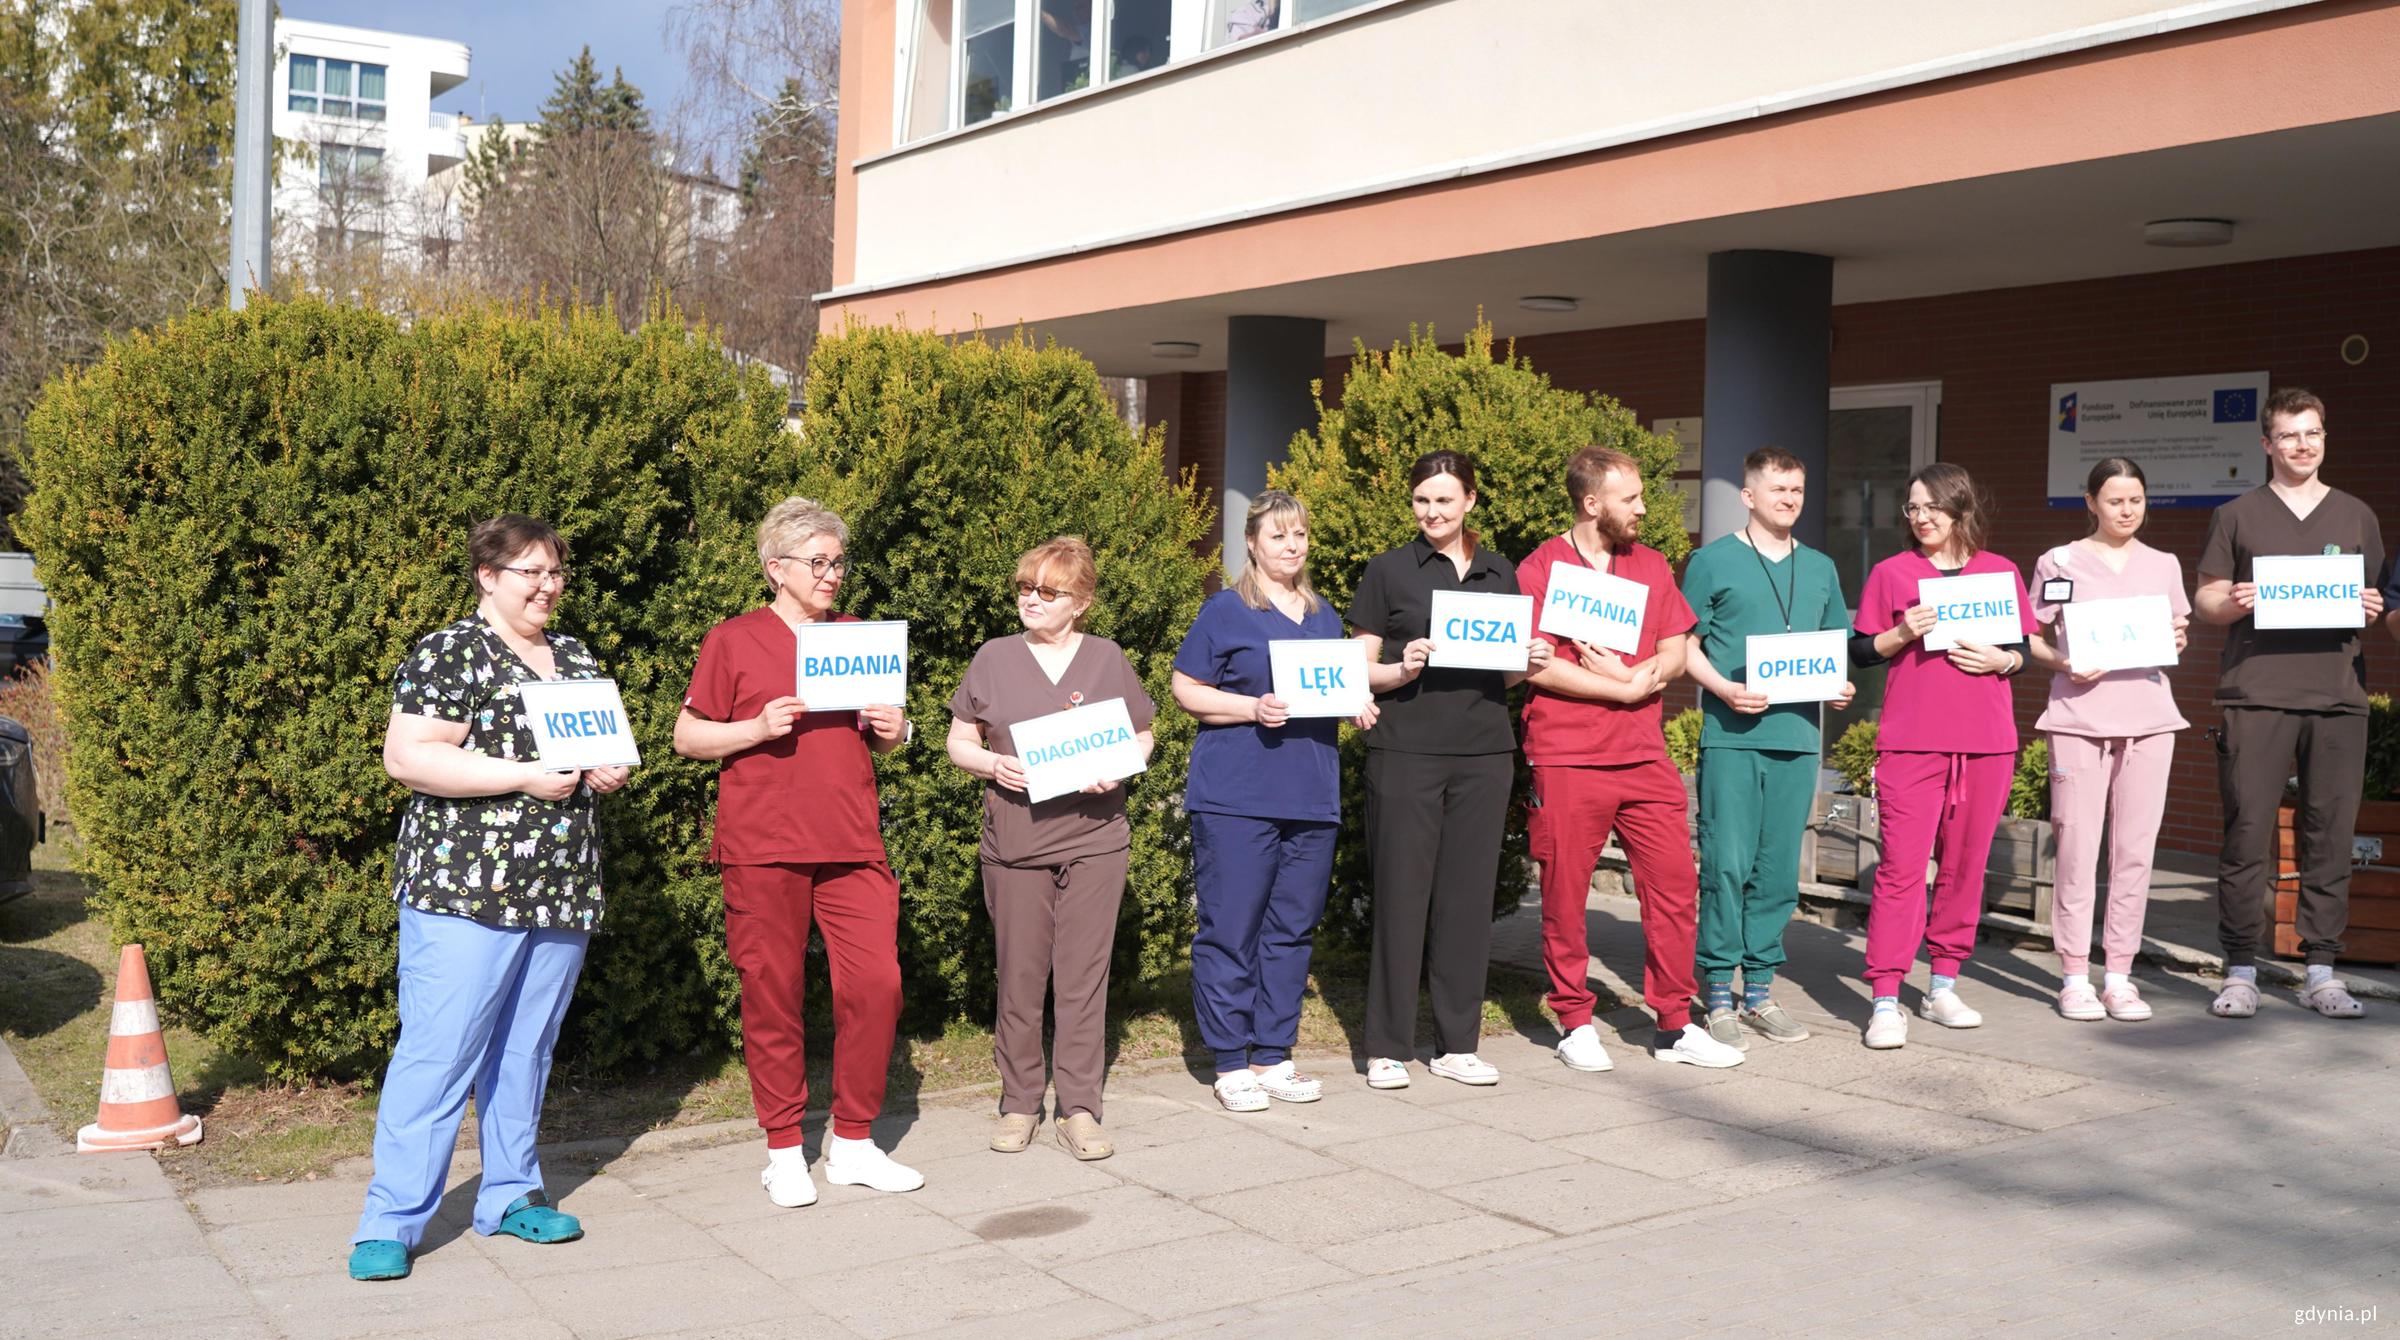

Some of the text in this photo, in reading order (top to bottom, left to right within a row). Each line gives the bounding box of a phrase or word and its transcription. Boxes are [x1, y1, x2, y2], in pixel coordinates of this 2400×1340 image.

[2259, 583, 2360, 601] WSPARCIE
[1551, 588, 1638, 628] PYTANIA
[1936, 599, 2015, 622] ECZENIE
[1445, 617, 1518, 644] CISZA
[804, 654, 903, 678] BADANIA
[1757, 656, 1838, 680] OPIEKA
[1299, 665, 1346, 697] LĘK
[544, 709, 618, 739] KREW
[1025, 726, 1132, 767] DIAGNOZA
